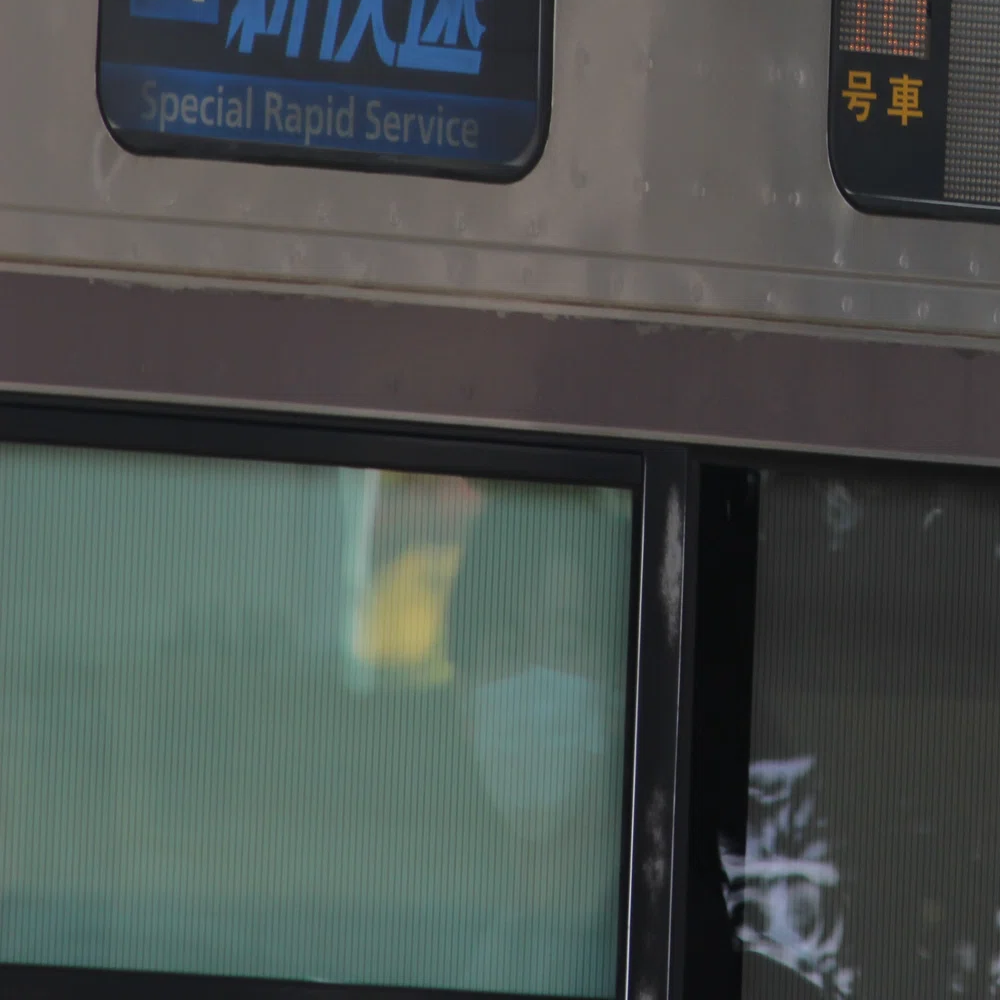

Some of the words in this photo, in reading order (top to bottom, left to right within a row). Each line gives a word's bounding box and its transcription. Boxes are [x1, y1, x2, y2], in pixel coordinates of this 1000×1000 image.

[140, 79, 253, 132] Special
[264, 89, 355, 146] Rapid
[365, 100, 479, 149] Service
[842, 69, 924, 126] 号車
